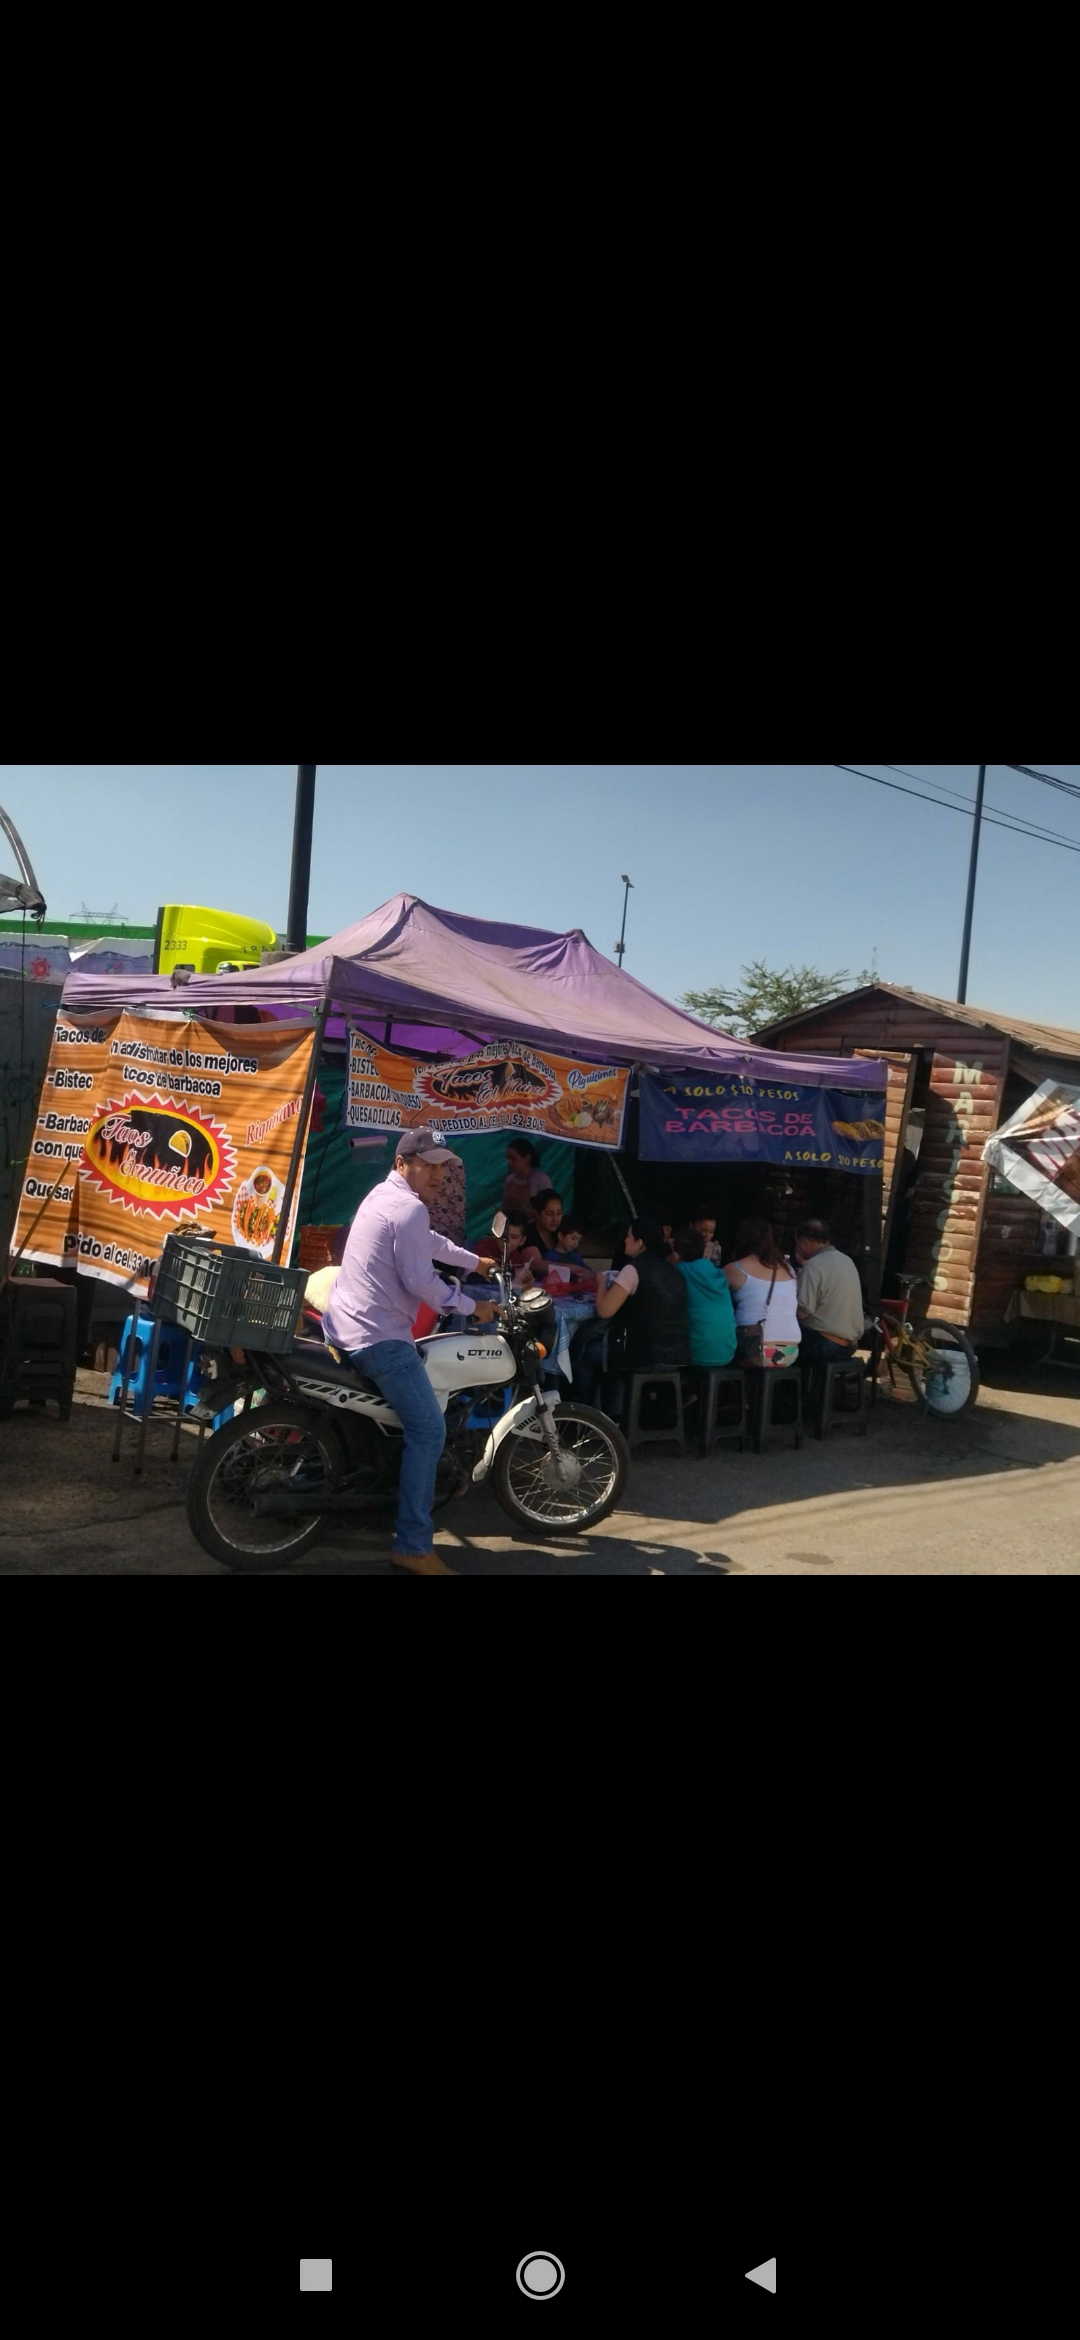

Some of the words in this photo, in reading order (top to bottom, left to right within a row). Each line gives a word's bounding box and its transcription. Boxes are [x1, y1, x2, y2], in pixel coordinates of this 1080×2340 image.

[164, 940, 188, 951] 2333
[56, 1026, 89, 1043] Tacos
[91, 1027, 106, 1044] de:
[169, 1050, 182, 1066] de
[186, 1051, 201, 1067] los
[205, 1053, 257, 1074] mejores
[48, 1071, 93, 1088] -Bistec
[168, 1075, 221, 1096] barbacoa
[432, 1063, 493, 1094] Tacos
[351, 1082, 390, 1101] BARBACOA
[685, 1085, 725, 1097] SOLO
[759, 1088, 799, 1101] PESOS
[349, 1106, 401, 1126] QUESADILLAS
[442, 1118, 477, 1130] PEDIDO
[479, 1117, 488, 1128] AL
[512, 1114, 524, 1126] 52
[526, 1117, 537, 1129] 30
[675, 1107, 776, 1122] TACOS
[784, 1112, 813, 1125] DE
[665, 1120, 816, 1137] BARBACOA
[34, 1141, 62, 1157] con
[785, 1151, 793, 1161] A
[796, 1152, 832, 1162] SOLO
[932, 1060, 984, 1292] MARISCOS
[104, 1244, 113, 1262] al
[115, 1250, 131, 1268] cel.
